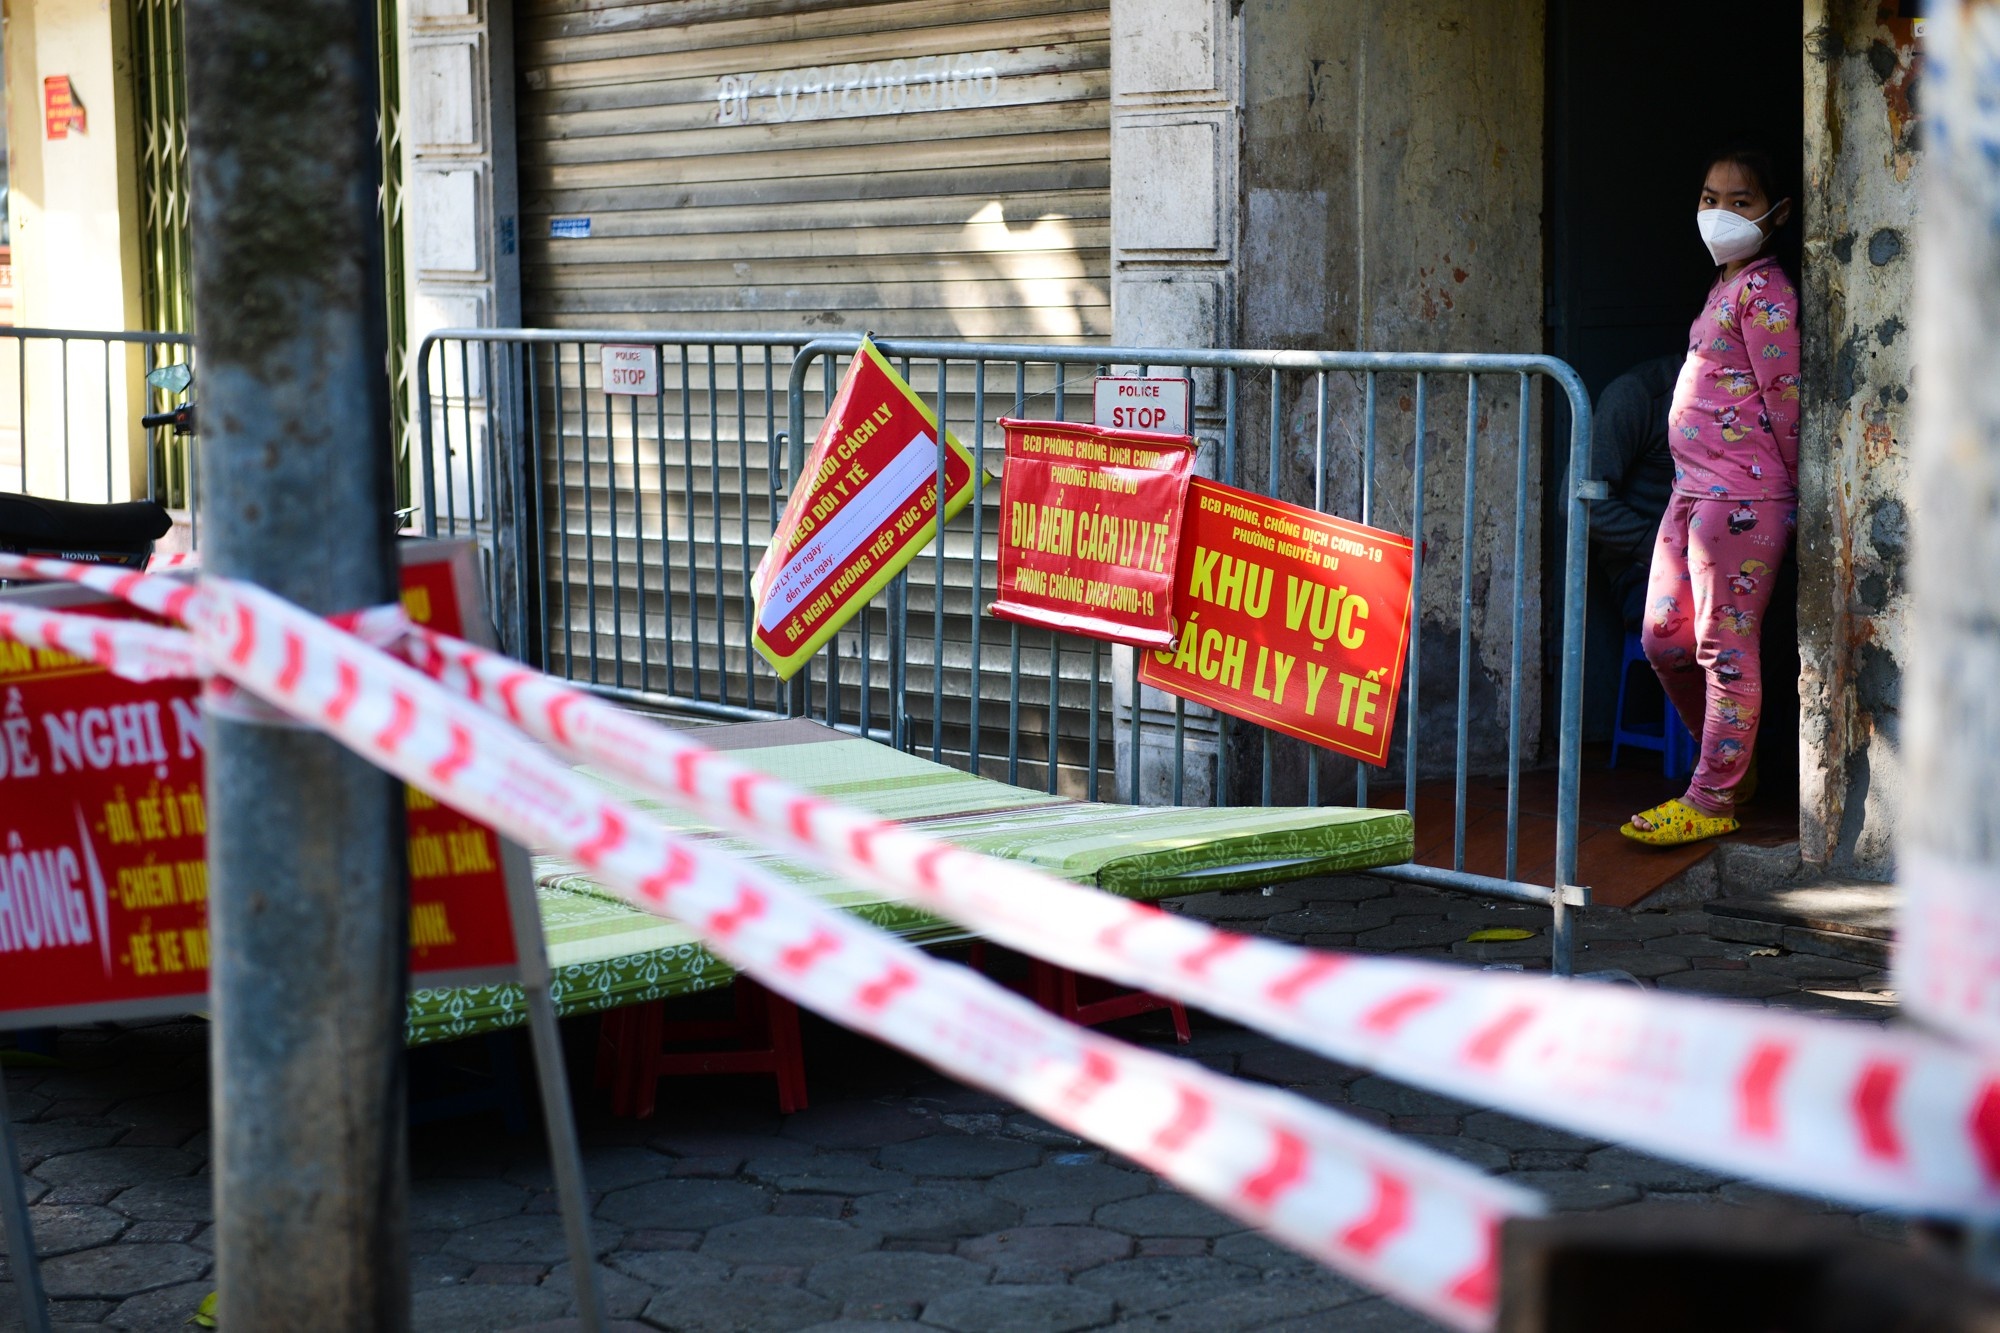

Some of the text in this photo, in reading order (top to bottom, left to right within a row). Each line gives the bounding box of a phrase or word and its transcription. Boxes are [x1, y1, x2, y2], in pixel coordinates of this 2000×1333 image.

[612, 368, 646, 385] STOP
[615, 351, 641, 361] POLICE
[1118, 385, 1160, 397] POLICE
[837, 419, 879, 460] CÁCH
[872, 402, 894, 426] LY
[1112, 406, 1167, 429] STOP
[1023, 434, 1174, 472] BCĐ PHÒNG CHỐNG DỊCH COVID-19
[1050, 464, 1087, 487] PHƯỜNG
[1124, 477, 1139, 495] DU
[785, 515, 816, 554] THEO
[811, 491, 841, 522] DÕI
[834, 480, 850, 497] Y
[845, 458, 870, 487] TẾ
[1011, 488, 1172, 574] ĐỊA ĐIỂM CÁCH LY Y TẾ
[1199, 495, 1383, 563] BCĐ PHÒNG, CHỐNG DỊCH COVID-19
[61, 552, 101, 562] HONDA
[784, 615, 805, 643] ĐỀ
[801, 591, 835, 627] NGHỊ
[829, 554, 873, 600] KHÔNG
[868, 530, 896, 561] TIẾP
[894, 505, 922, 537] XÚC
[1232, 526, 1340, 571] PHƯỜNG NGUYỄN DU
[785, 553, 836, 604] đến hết ngày:
[1014, 563, 1155, 617] PHÒNG CHỐNG DỊCH COVID-19
[1188, 545, 1371, 653] KHU VỰC
[1252, 645, 1297, 706] LY
[1304, 661, 1329, 717] Y
[1336, 666, 1389, 737] TẾ
[41, 700, 169, 780] NGHỊ
